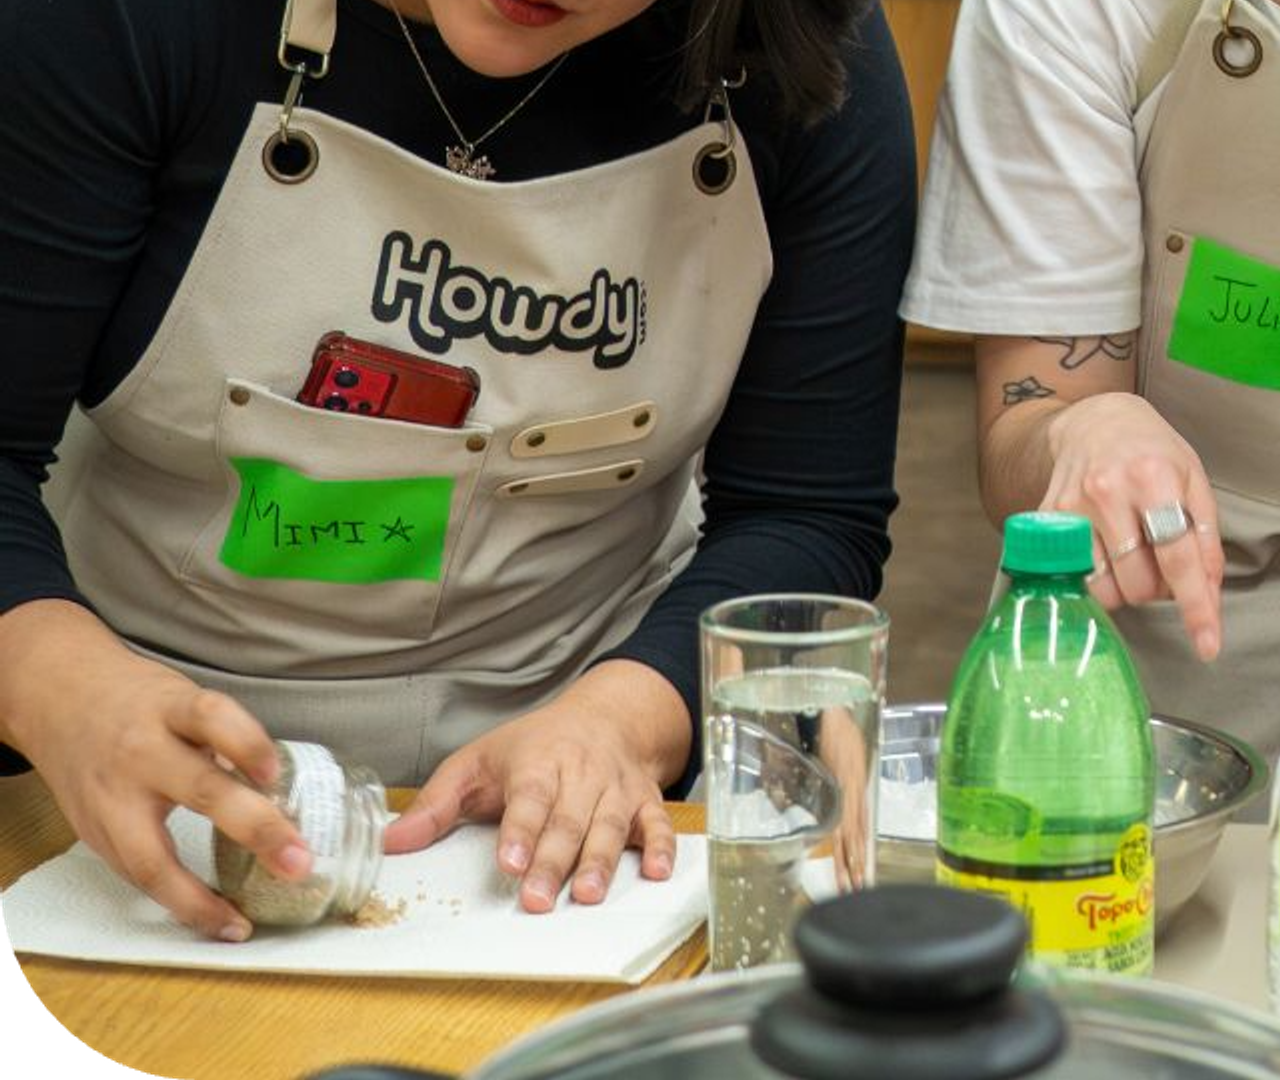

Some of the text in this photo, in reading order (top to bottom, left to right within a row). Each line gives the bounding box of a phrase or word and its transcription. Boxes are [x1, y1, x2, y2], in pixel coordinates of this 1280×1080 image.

[371, 230, 639, 370] Howdy
[242, 484, 367, 548] MIMI
[1077, 892, 1134, 930] Topo
